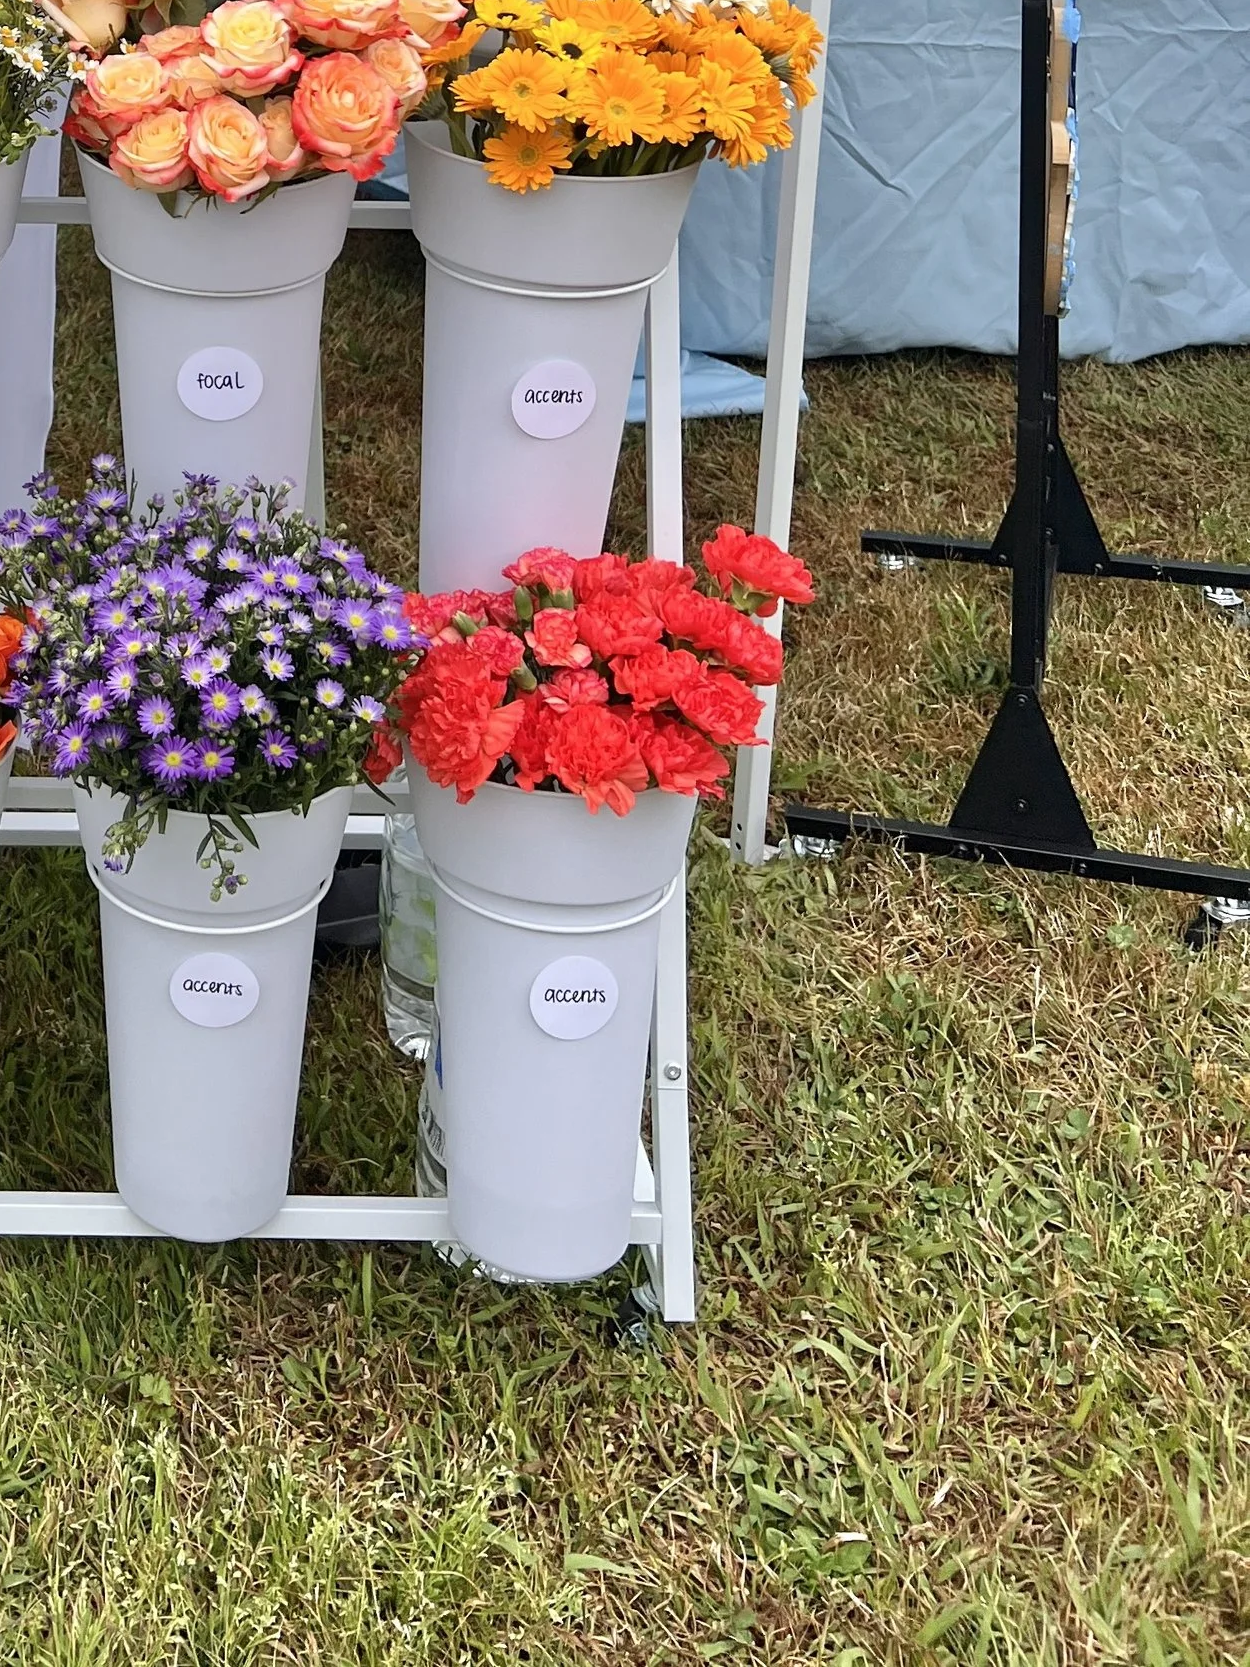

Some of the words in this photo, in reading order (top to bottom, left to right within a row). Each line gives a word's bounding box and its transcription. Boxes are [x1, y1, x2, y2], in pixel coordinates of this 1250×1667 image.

[196, 371, 246, 390] focal
[524, 388, 583, 405] accents
[182, 977, 243, 997] accents
[544, 987, 607, 1004] accents
